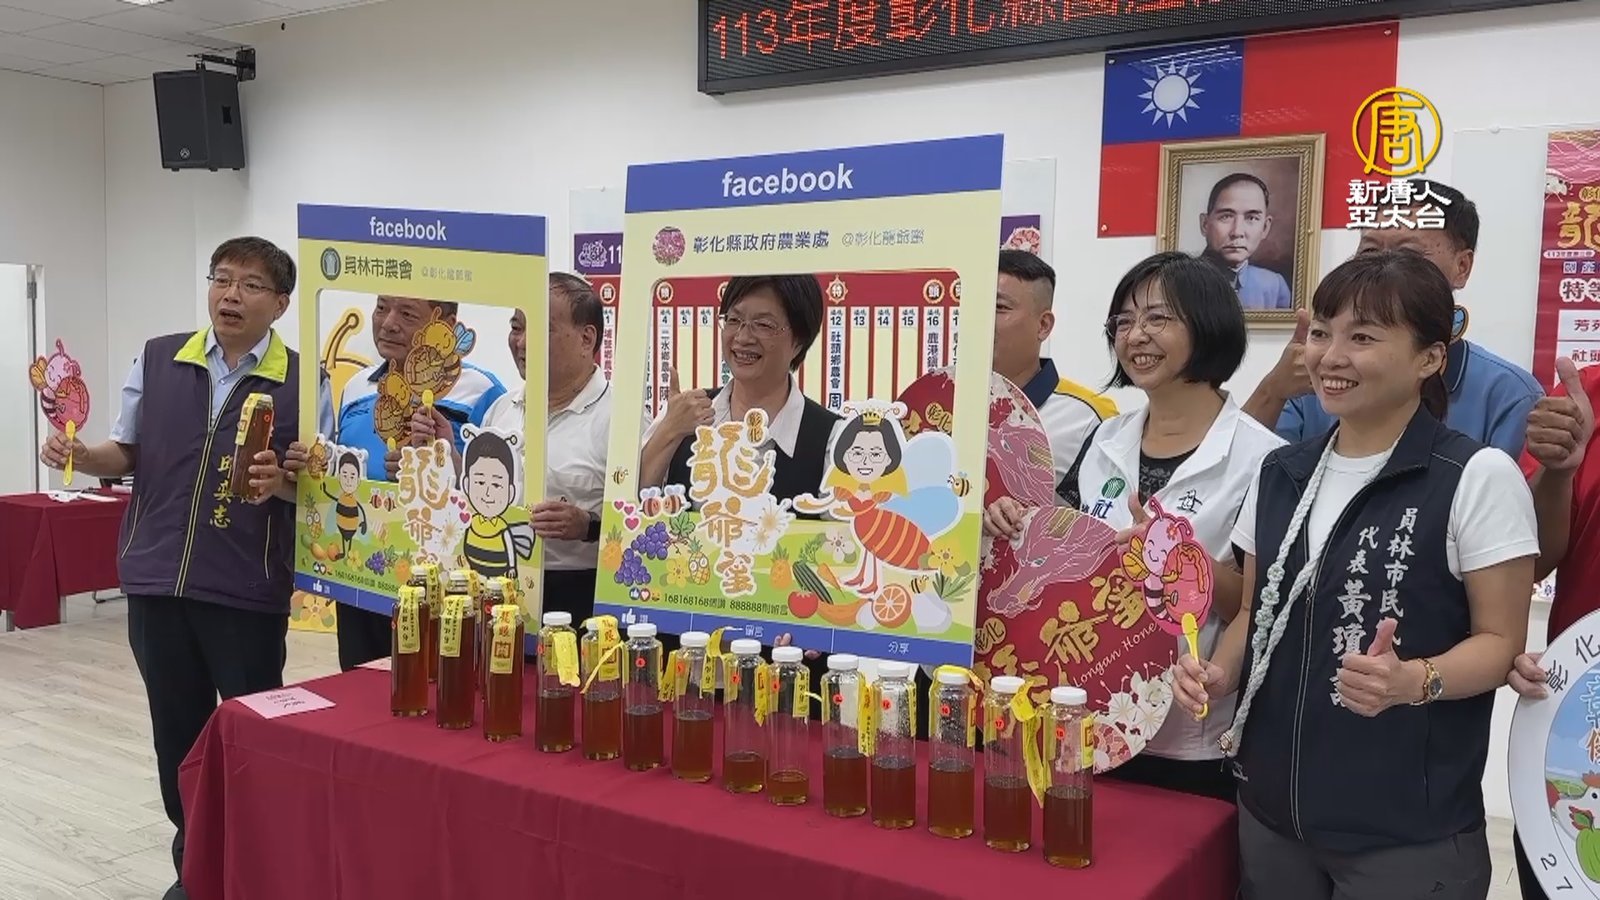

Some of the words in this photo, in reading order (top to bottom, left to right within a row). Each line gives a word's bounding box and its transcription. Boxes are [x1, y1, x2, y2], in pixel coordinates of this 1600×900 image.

[722, 163, 853, 197] facebook
[369, 216, 447, 241] facebook
[693, 230, 830, 253] 彰化縣政府農業處
[344, 255, 413, 280] 員林市農會
[662, 316, 668, 324] 4
[682, 316, 688, 325] 5
[830, 316, 842, 326] 12
[853, 316, 865, 326] 13
[877, 316, 889, 326] 14
[902, 316, 914, 326] 15
[927, 316, 939, 326] 16
[661, 329, 670, 383] 二水鄉農會
[830, 331, 841, 389] 社頭鄉農會
[927, 332, 939, 374] 鹿港鎮
[828, 393, 842, 409] 周
[748, 411, 763, 443] 彰化
[1346, 526, 1380, 574] 代表
[1379, 508, 1418, 646] 員林市民
[888, 640, 910, 655] 分享
[1072, 649, 1122, 689] Longan
